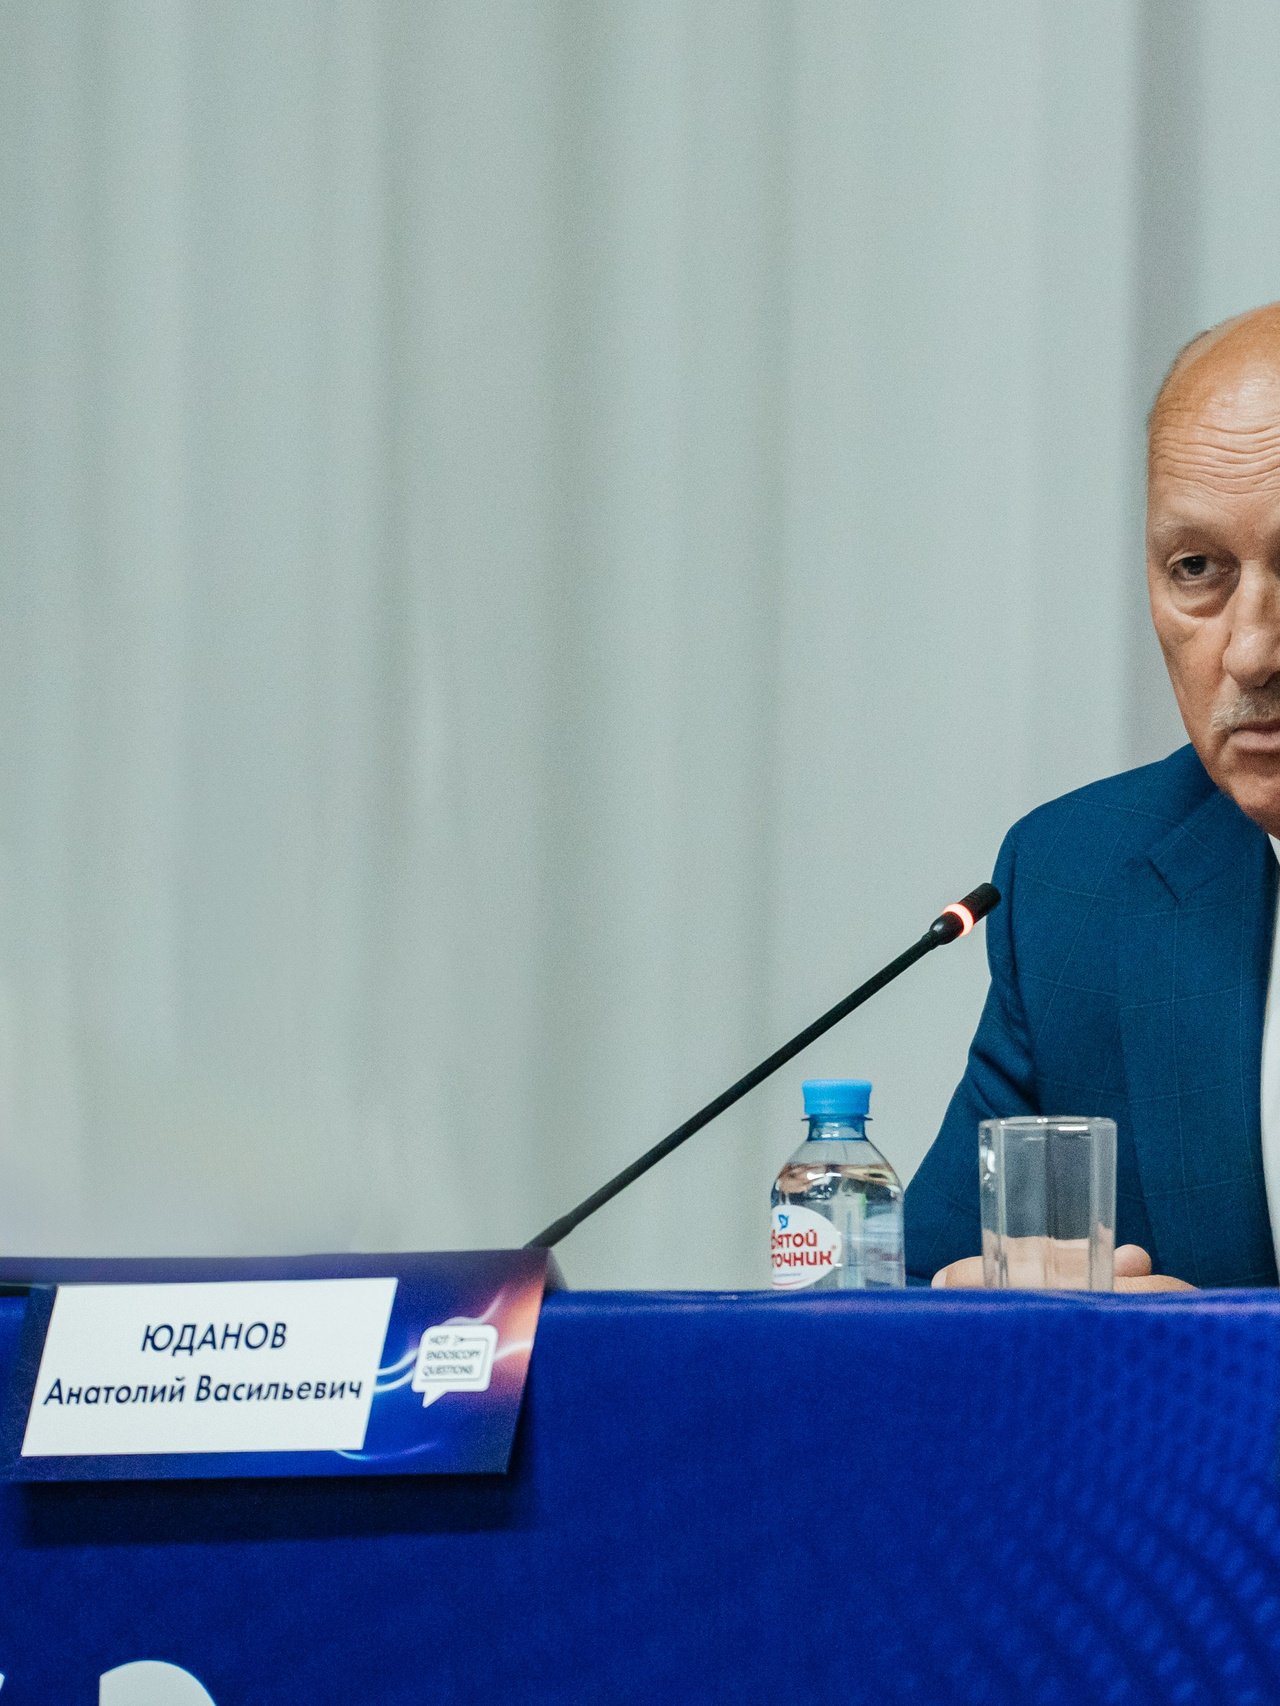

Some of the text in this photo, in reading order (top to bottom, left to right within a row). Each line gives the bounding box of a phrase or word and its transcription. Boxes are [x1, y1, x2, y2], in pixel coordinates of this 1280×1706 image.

[141, 1322, 288, 1357] ЮДАНОВ
[42, 1374, 364, 1407] Анатолий Васильевич
